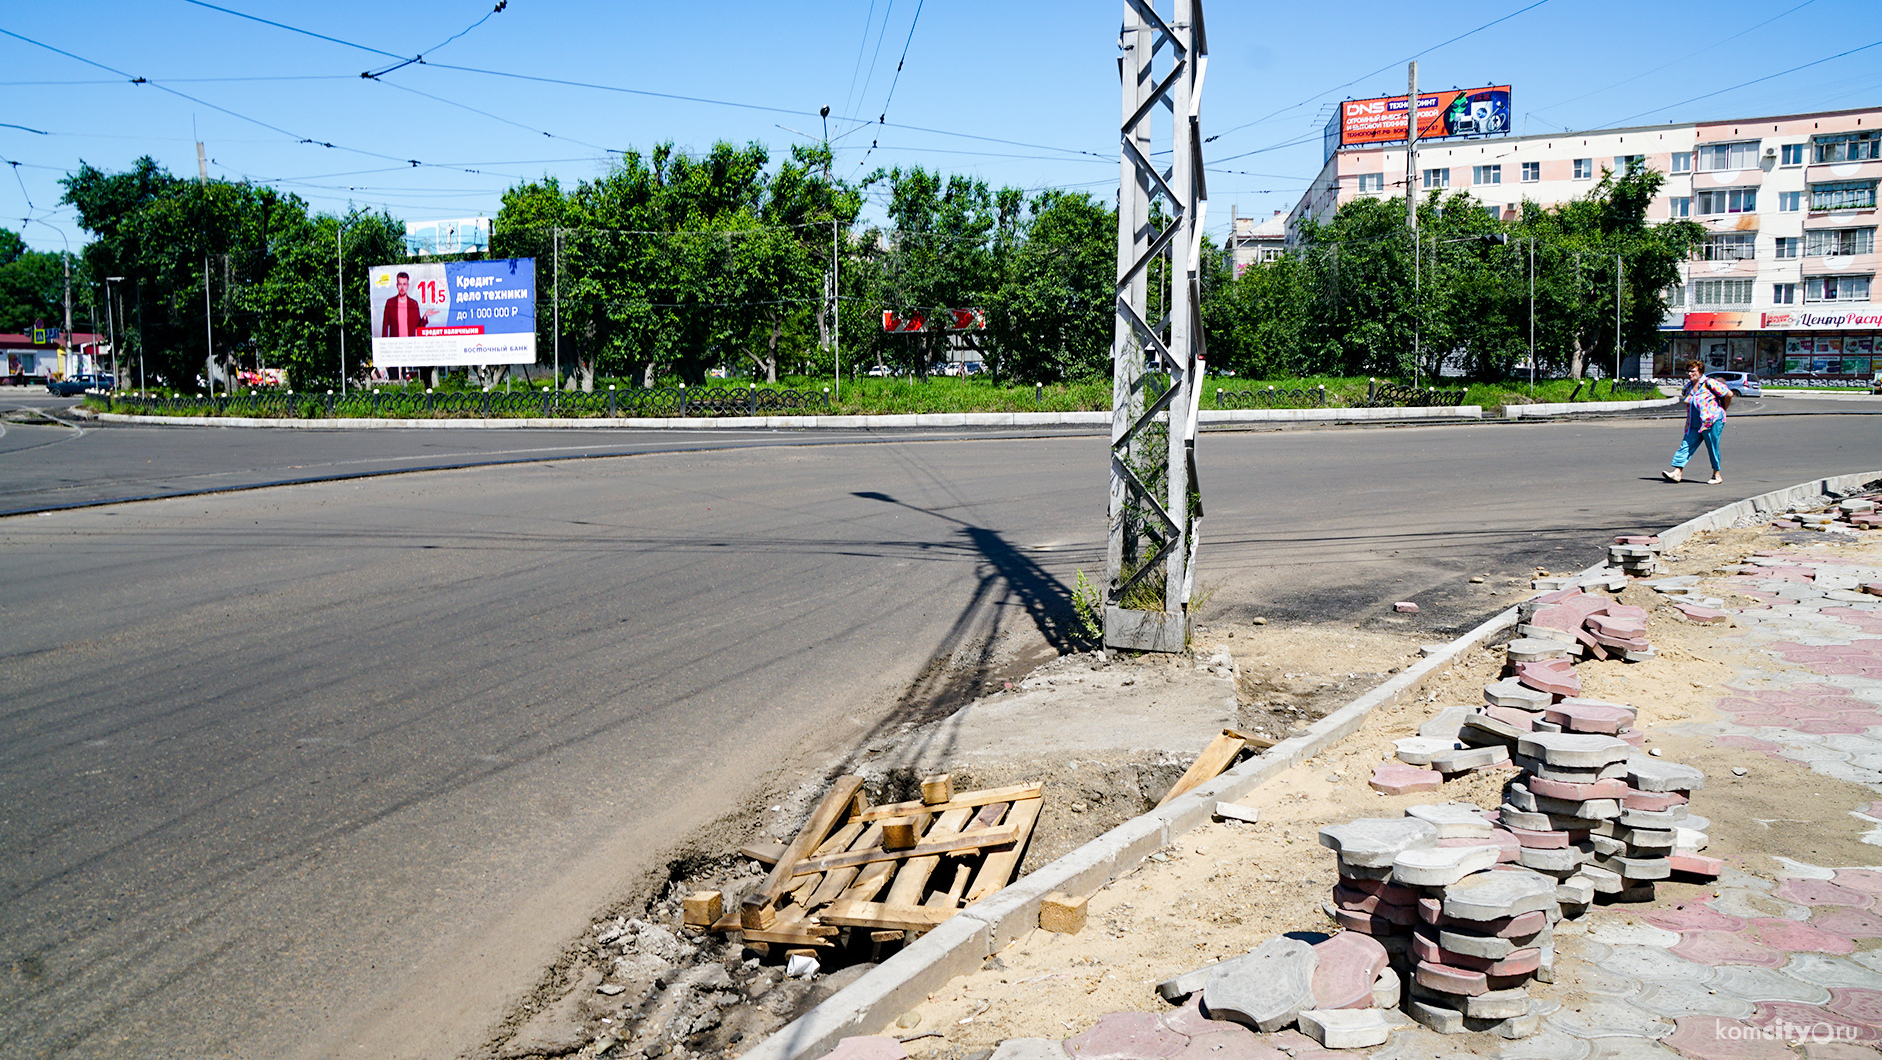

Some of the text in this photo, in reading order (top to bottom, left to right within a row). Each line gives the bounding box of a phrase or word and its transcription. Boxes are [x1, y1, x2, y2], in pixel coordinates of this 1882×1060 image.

[1347, 102, 1385, 116] DNS
[1346, 114, 1380, 125] ОГРОМНЫЙ
[1353, 122, 1382, 131] БЫТОВОЙ
[456, 275, 494, 289] Кредит
[456, 289, 528, 304] дело техники
[456, 311, 468, 321] до
[470, 309, 474, 319] 1
[476, 308, 492, 319] 000
[493, 306, 509, 318] 000
